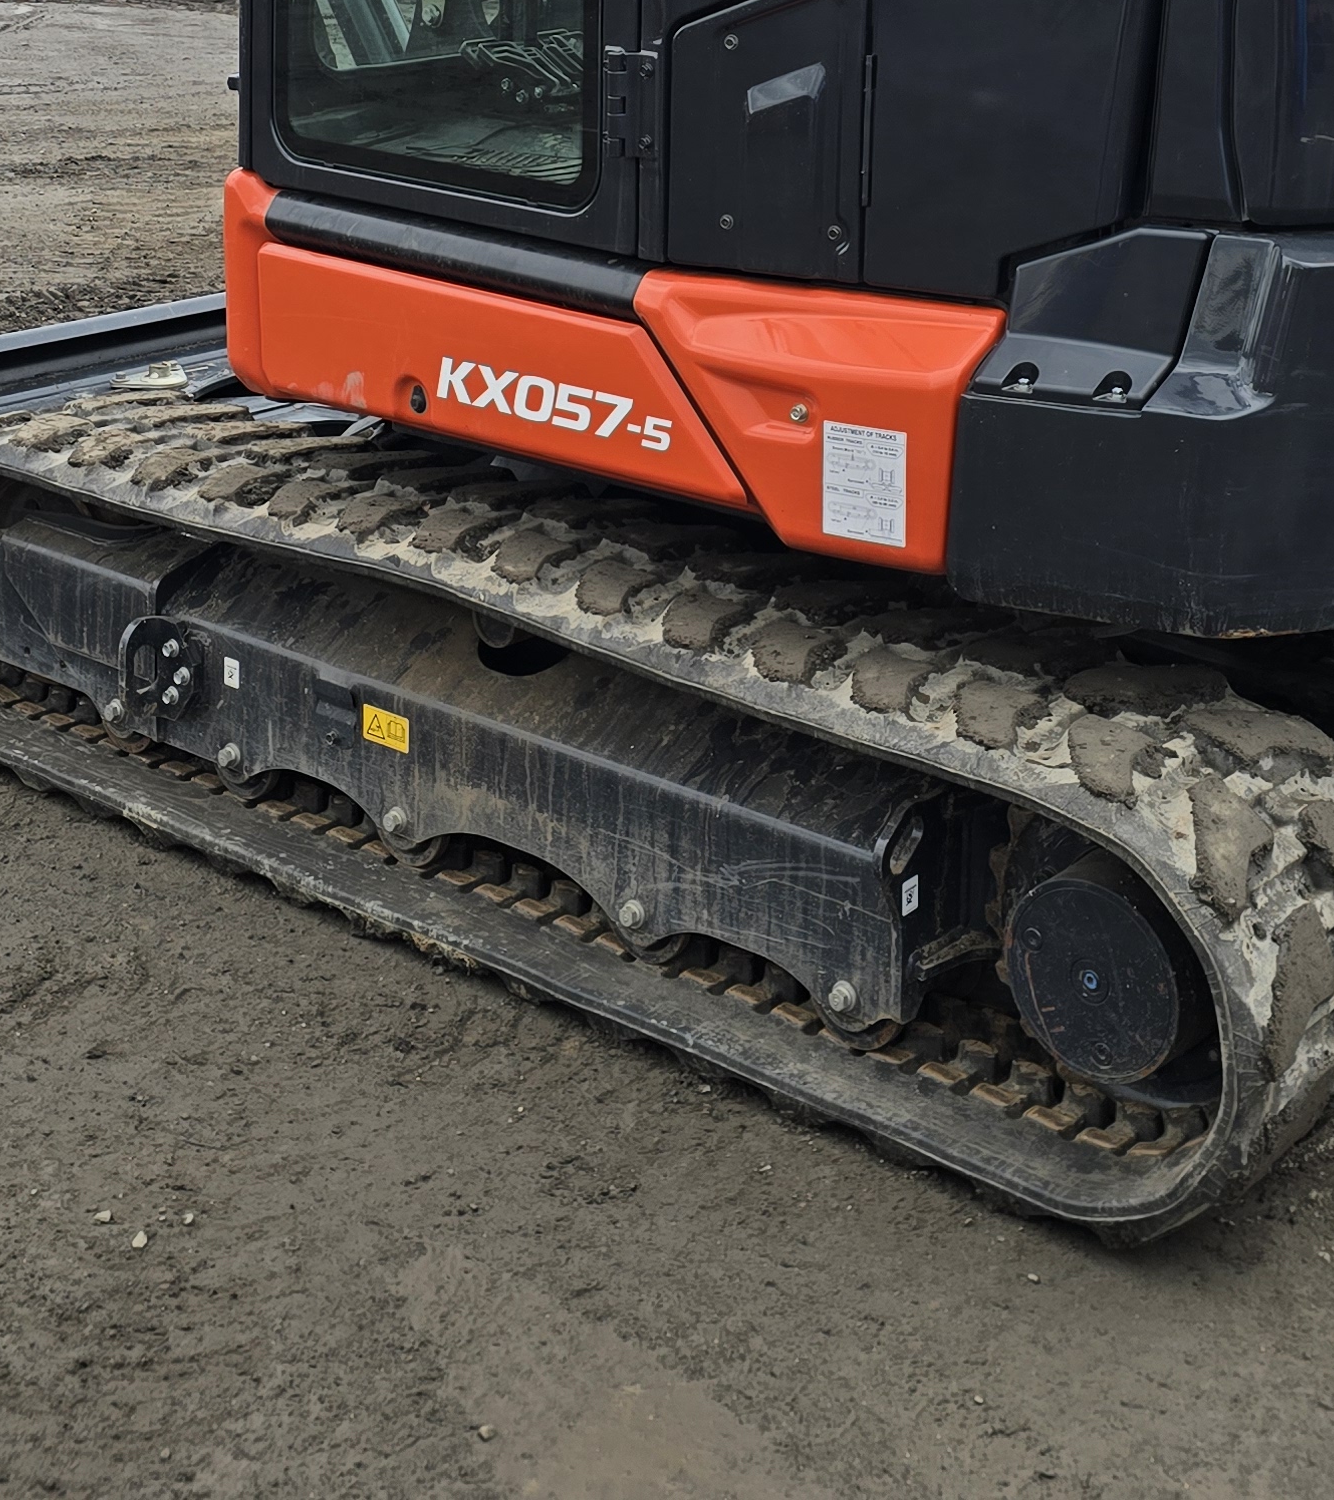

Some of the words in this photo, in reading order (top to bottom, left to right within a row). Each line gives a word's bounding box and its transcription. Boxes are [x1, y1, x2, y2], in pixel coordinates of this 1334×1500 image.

[436, 356, 673, 452] KX057-5
[830, 425, 866, 437] ADJUSTMENT
[866, 431, 874, 439] OF
[875, 432, 897, 442] TRACKS
